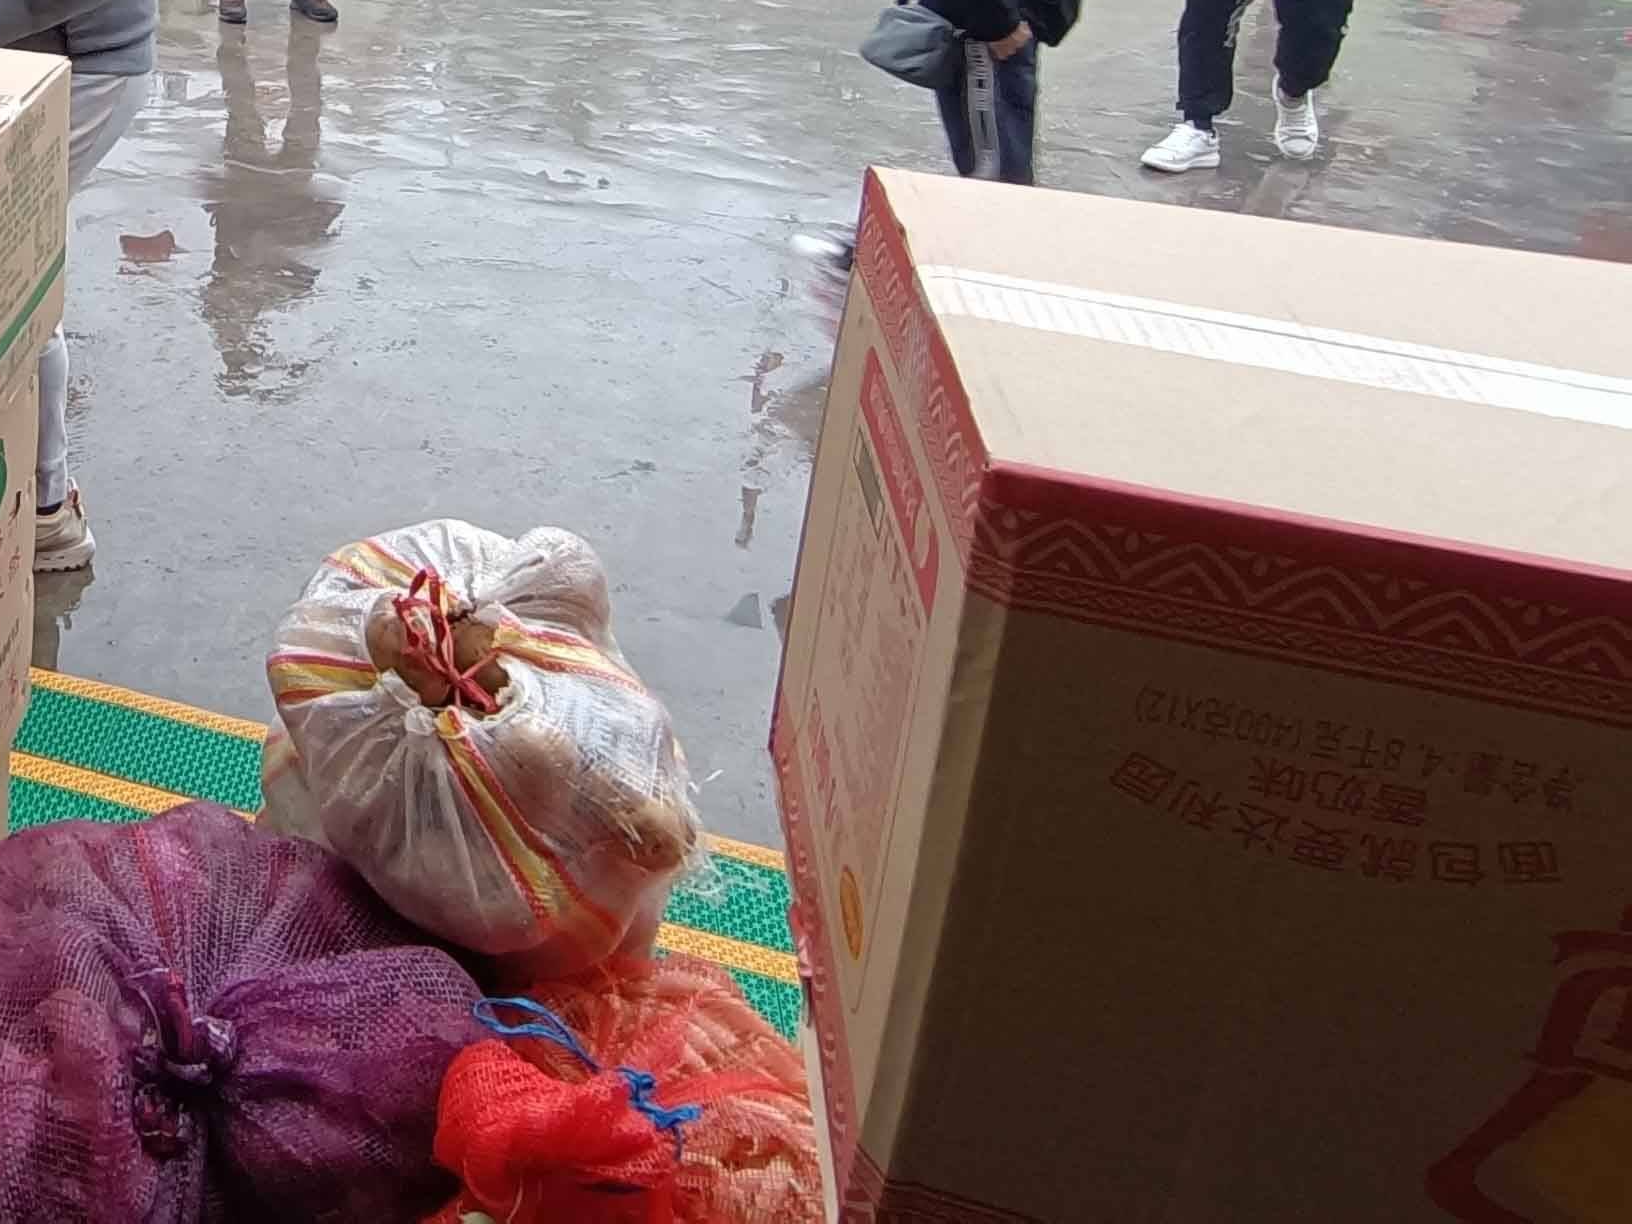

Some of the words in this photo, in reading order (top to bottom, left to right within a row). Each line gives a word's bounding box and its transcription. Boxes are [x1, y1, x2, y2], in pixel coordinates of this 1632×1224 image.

[1109, 750, 1563, 885] 面包就要达利园
